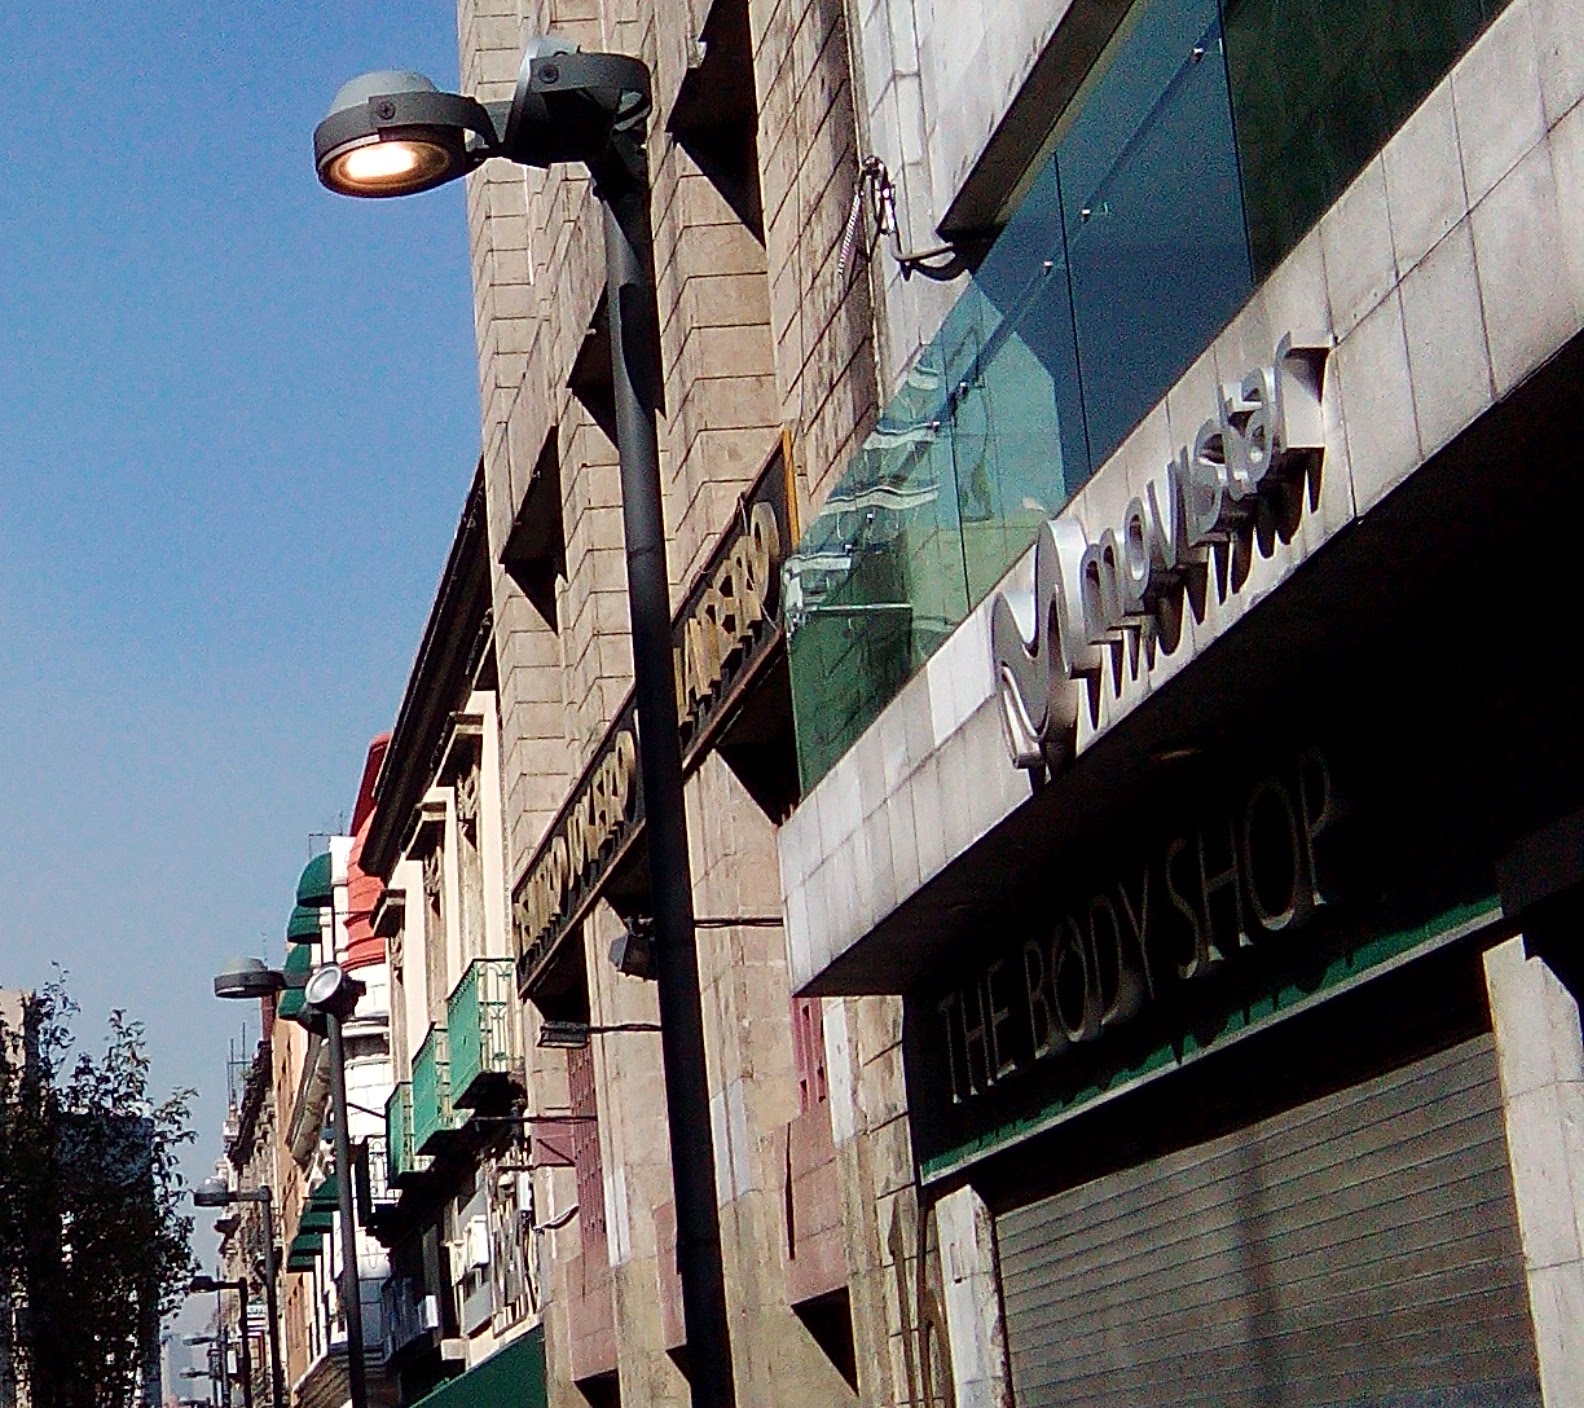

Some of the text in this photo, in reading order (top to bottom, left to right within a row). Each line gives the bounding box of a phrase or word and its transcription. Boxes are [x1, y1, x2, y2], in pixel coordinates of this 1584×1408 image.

[936, 742, 1333, 1105] THE BODY SHOP
